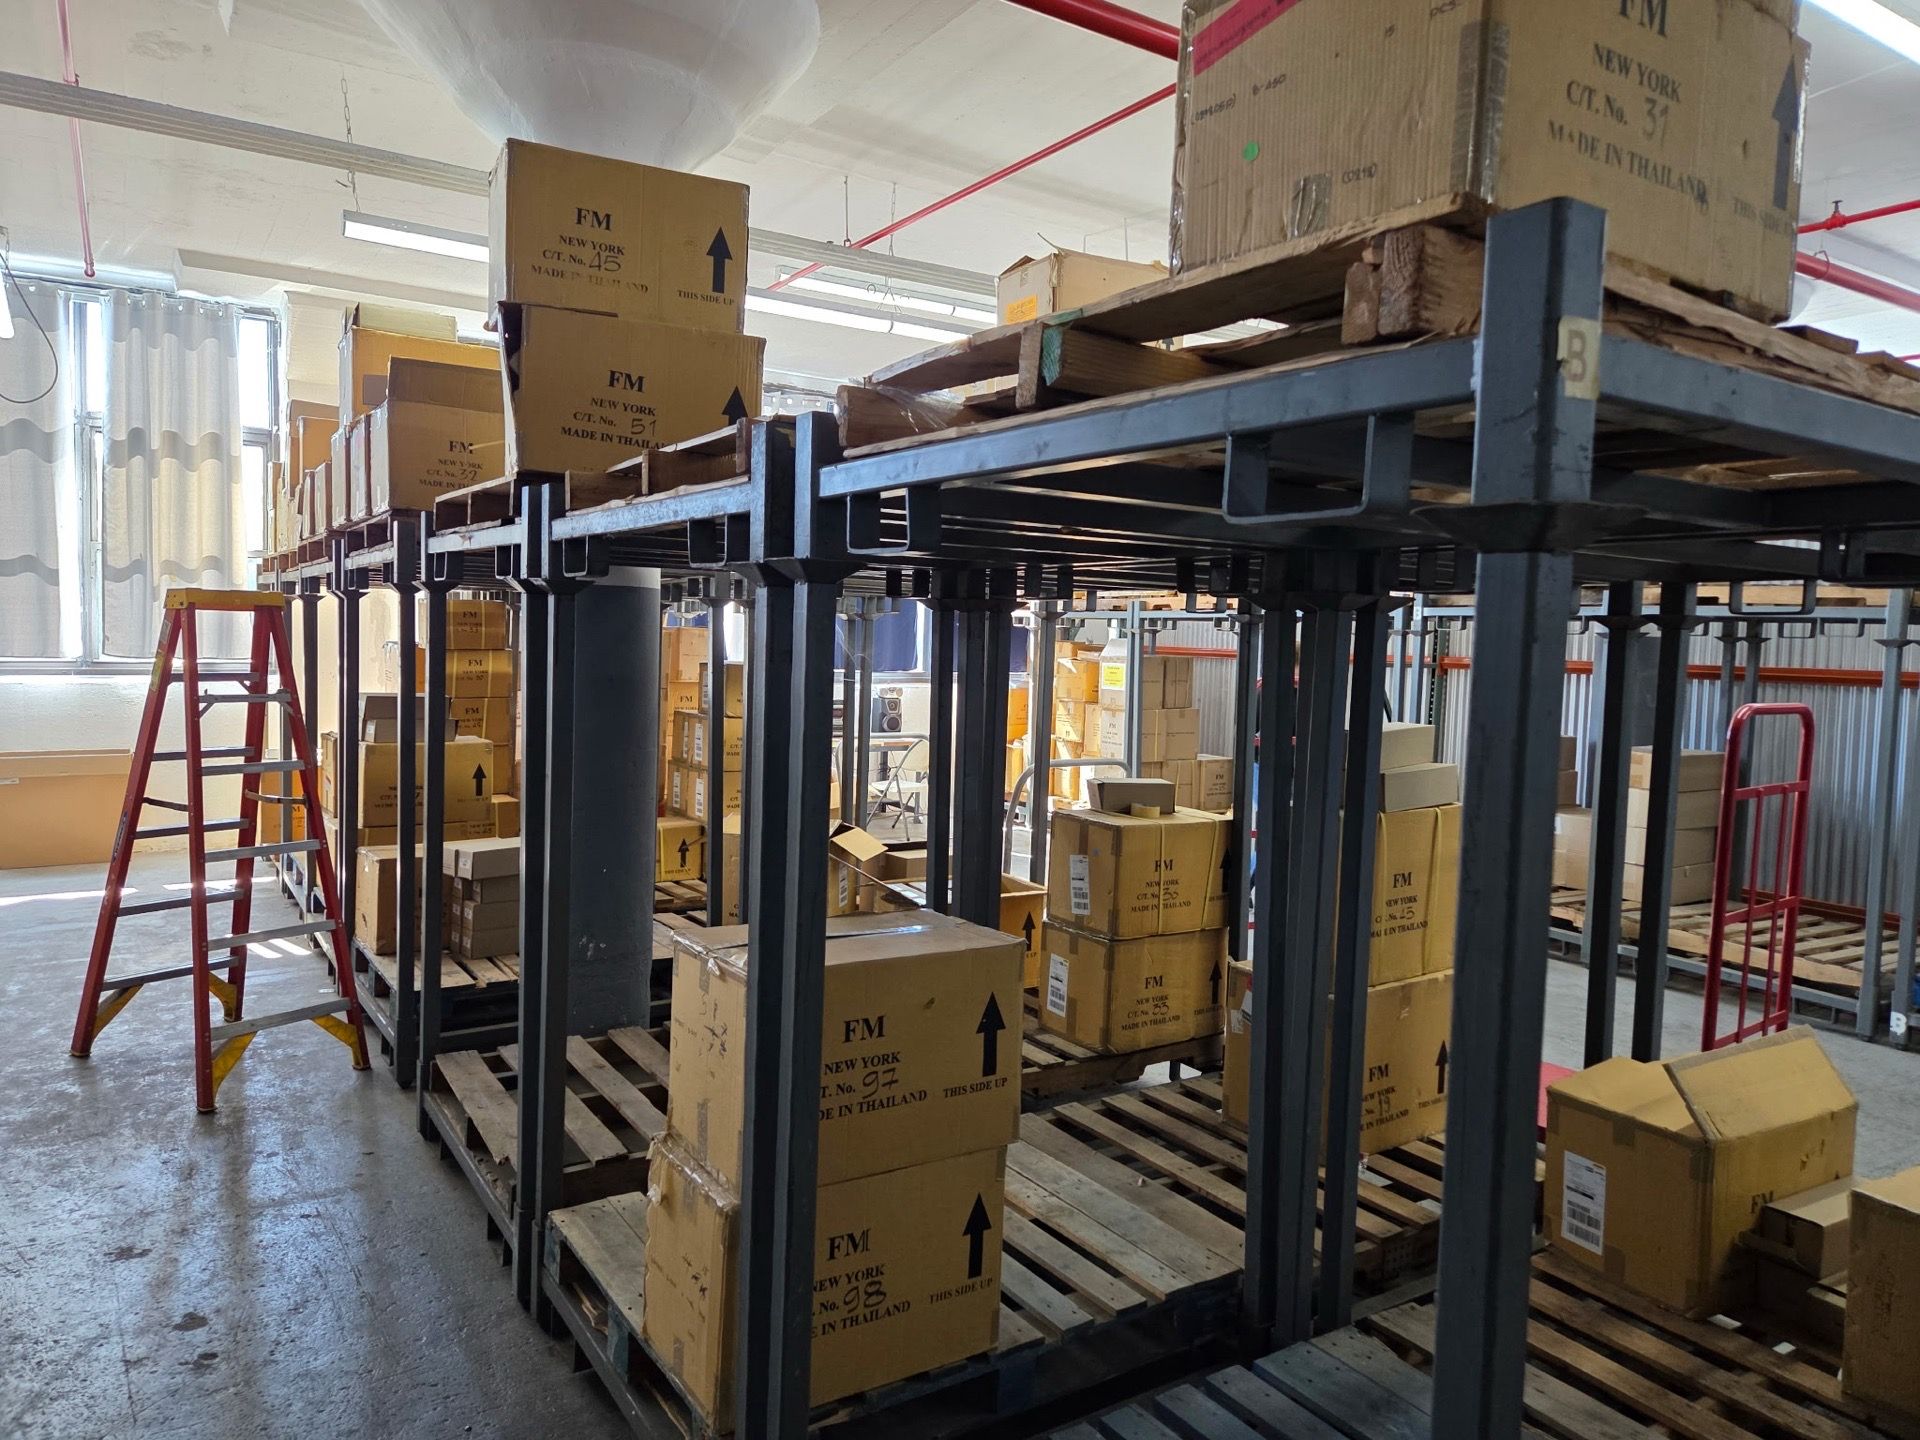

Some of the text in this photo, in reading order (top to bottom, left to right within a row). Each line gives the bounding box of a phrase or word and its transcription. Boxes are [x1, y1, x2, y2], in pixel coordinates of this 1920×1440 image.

[1594, 43, 1681, 104] NEW YORK
[1566, 79, 1599, 115] C/T.
[1604, 94, 1628, 125] No.
[1605, 142, 1624, 169] IN
[1625, 150, 1708, 201] THAILAND
[576, 207, 612, 231] FM
[559, 234, 625, 255] NEW YORK
[531, 264, 567, 279] MADE
[543, 249, 622, 272] C/T. No. 45
[677, 289, 735, 306] THIS SIDE UP
[608, 369, 645, 393] FM
[591, 397, 656, 417] NEW YORK
[573, 411, 657, 437] C/T. No. 51
[449, 441, 473, 454] FM
[561, 426, 665, 450] MADE IN THAILA
[419, 479, 442, 487] MADE
[1154, 859, 1174, 872] FM
[1145, 880, 1160, 888] NEW
[1393, 872, 1412, 888] FM
[1131, 903, 1149, 912] MADE
[1151, 903, 1159, 911] IN
[1397, 920, 1428, 933] THAILAND
[1144, 975, 1164, 989] FM
[1136, 994, 1169, 1006] NEW YORK
[842, 1015, 886, 1044] FM
[1121, 1015, 1181, 1031] MADE IN THAILAND
[824, 1051, 901, 1075] NEW YORK
[1369, 1063, 1388, 1082] FM
[836, 1083, 856, 1096] No.
[862, 1067, 899, 1100] 97
[943, 1077, 1008, 1099] THIS SIDE UP
[818, 1090, 928, 1121] DE IN THAILAND
[1363, 1092, 1376, 1102] EW
[827, 1228, 871, 1261] FM
[845, 1263, 886, 1285] YORK
[820, 1280, 887, 1314] No. 98
[929, 1277, 993, 1304] THIS SIDE UP
[821, 1320, 836, 1336] IN
[841, 1300, 911, 1330] THAILAND
